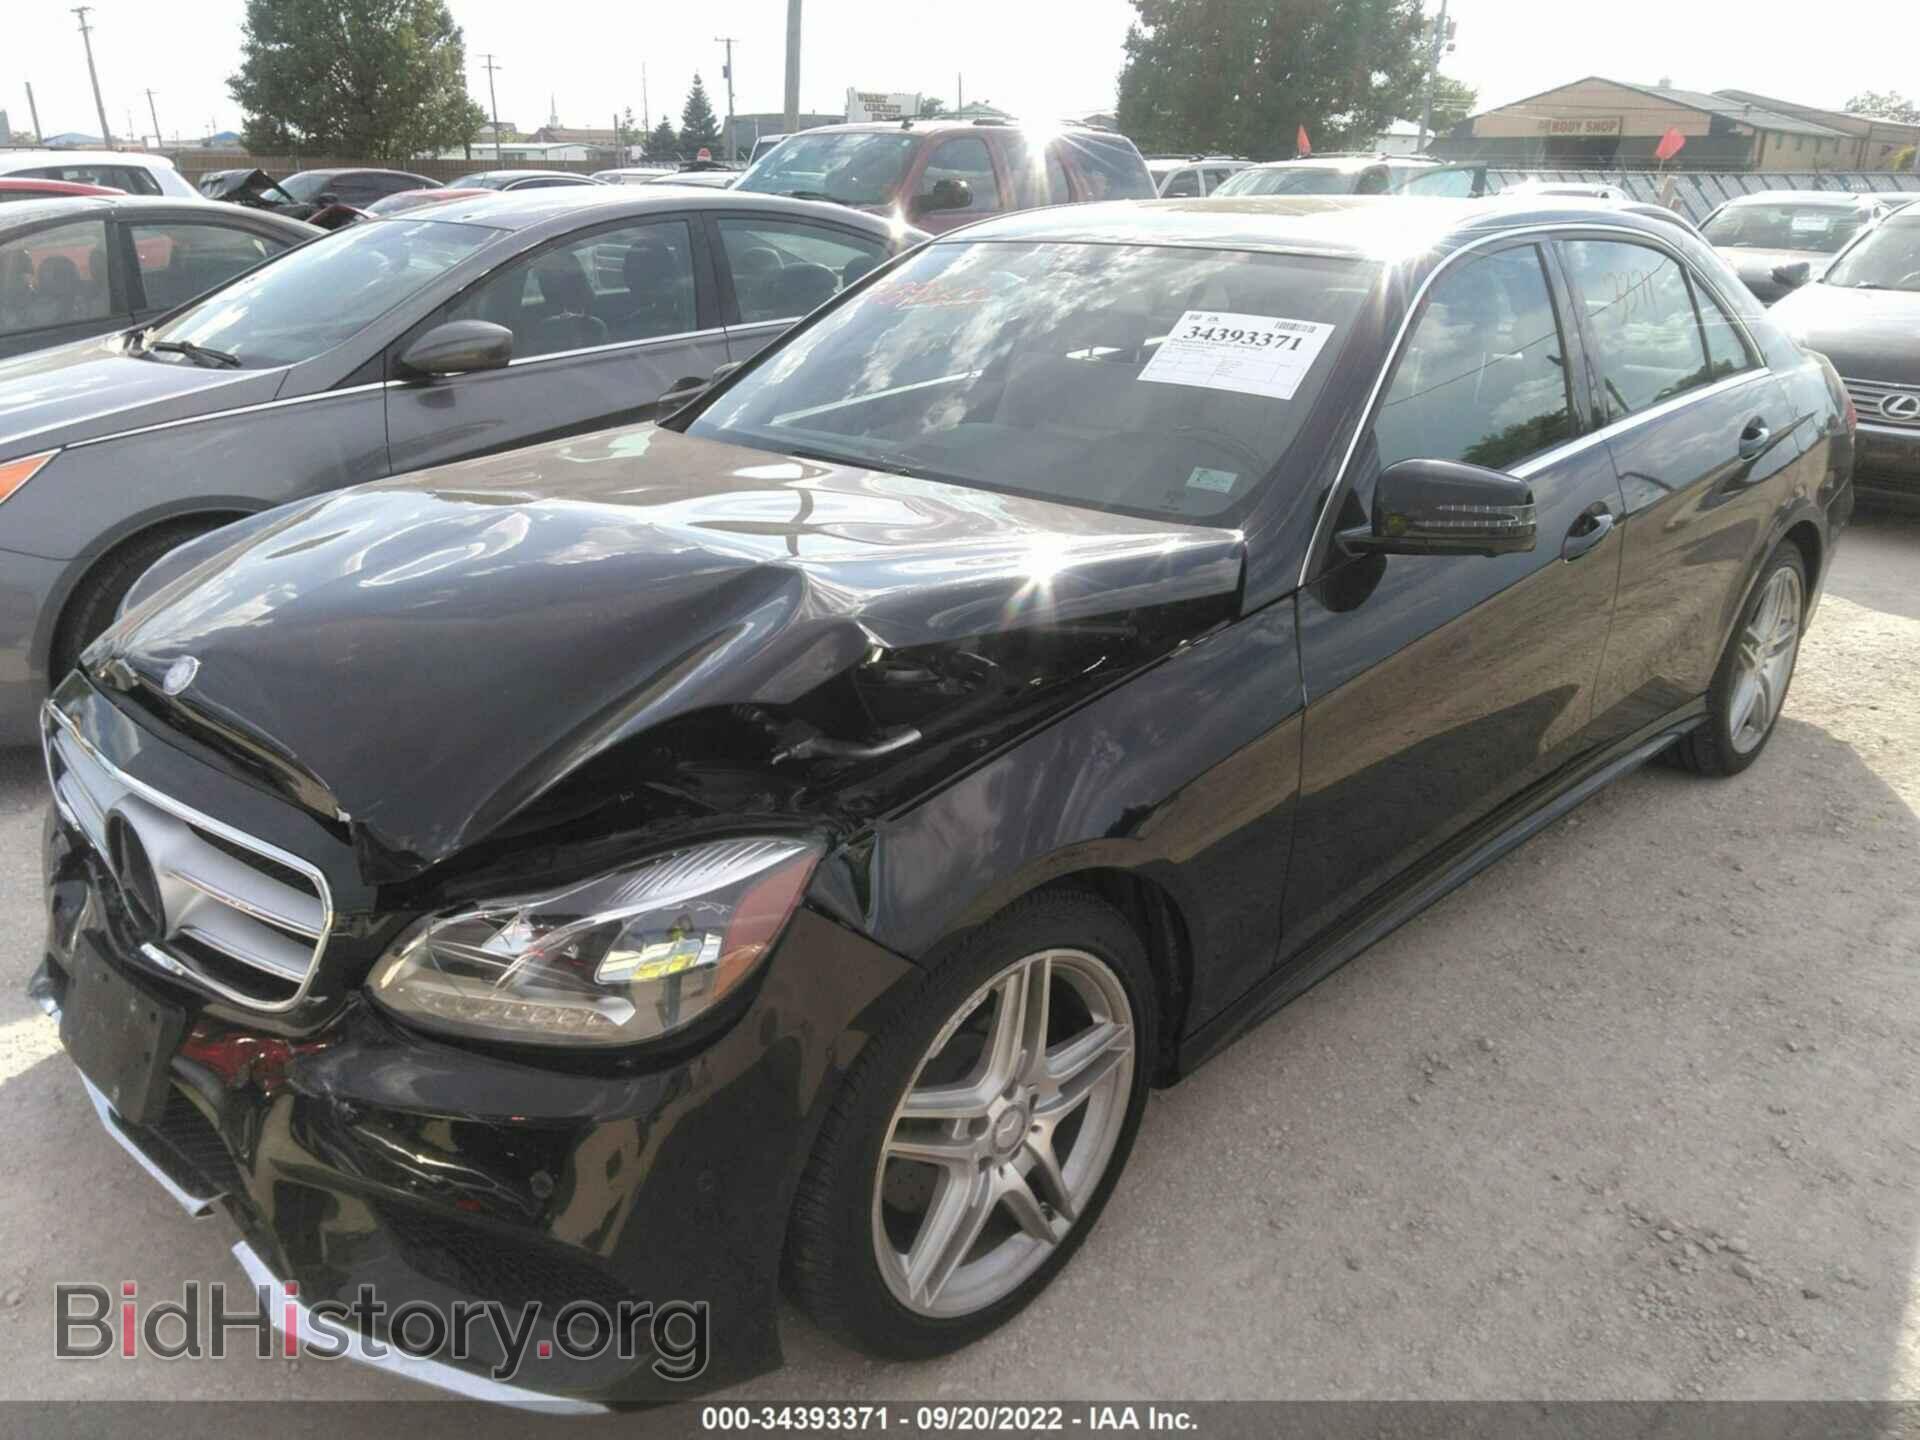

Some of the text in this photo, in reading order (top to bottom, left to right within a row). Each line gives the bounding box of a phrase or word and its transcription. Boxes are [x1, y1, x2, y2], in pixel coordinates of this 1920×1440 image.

[1551, 119, 1582, 133] BODY
[1585, 119, 1617, 133] SHOP
[1184, 325, 1304, 351] 34393371
